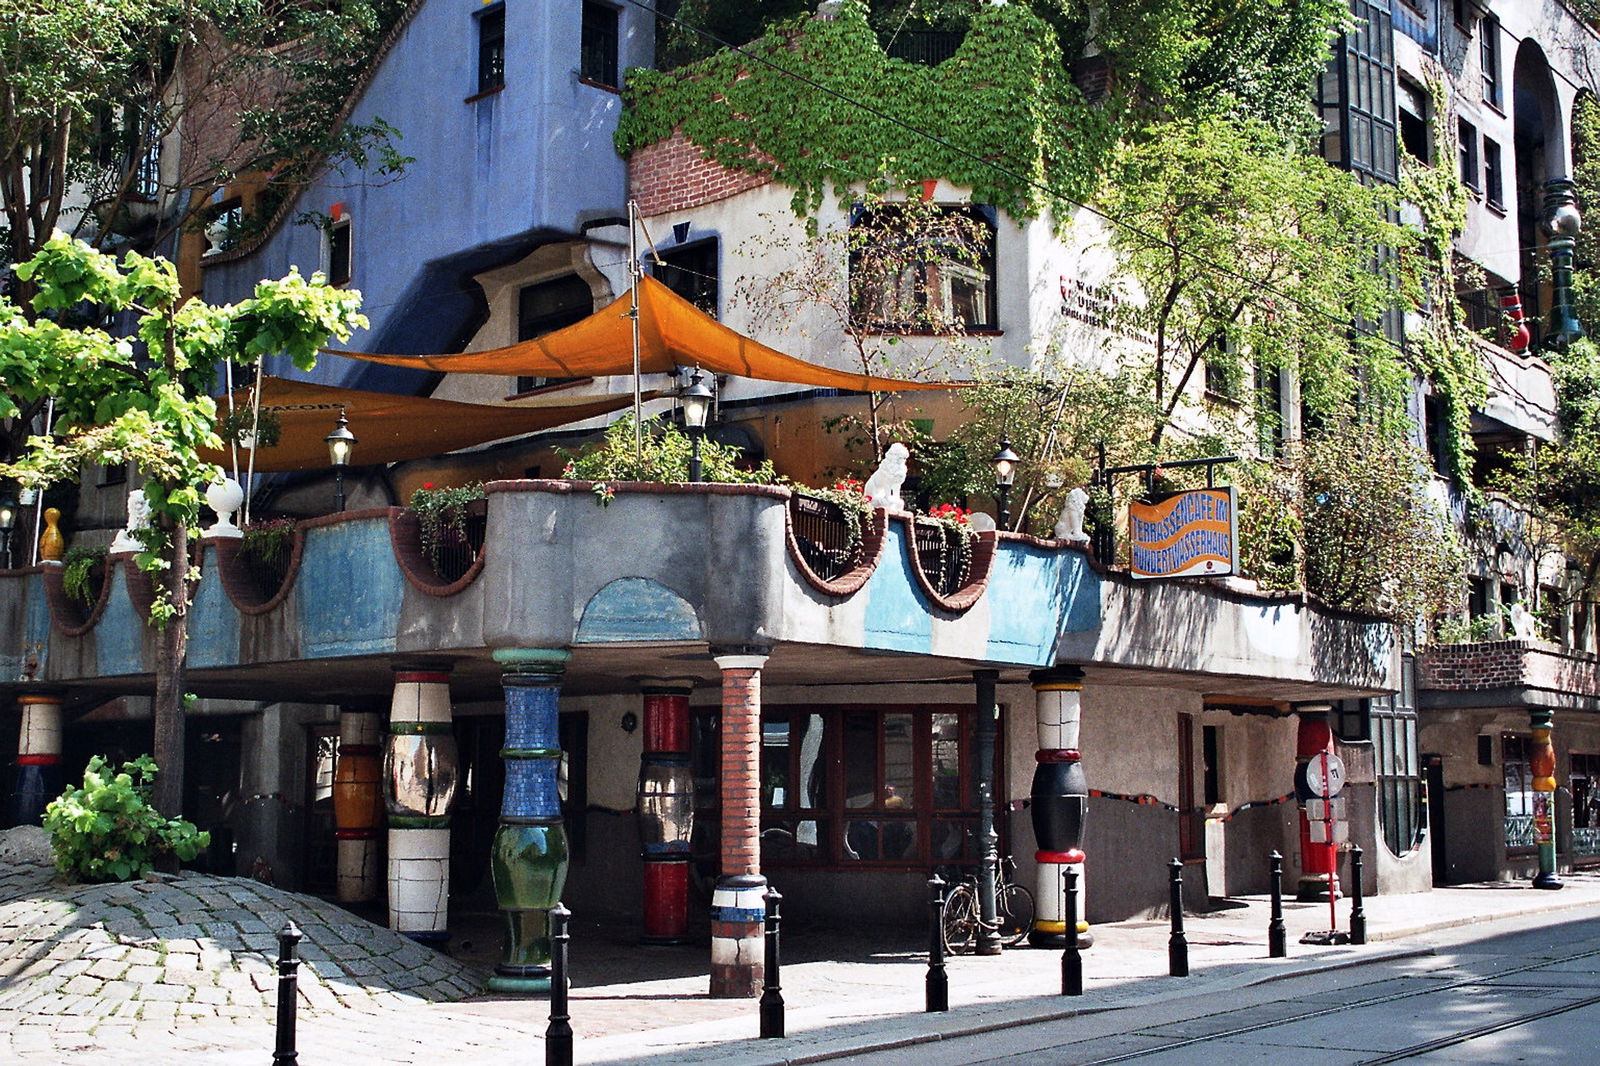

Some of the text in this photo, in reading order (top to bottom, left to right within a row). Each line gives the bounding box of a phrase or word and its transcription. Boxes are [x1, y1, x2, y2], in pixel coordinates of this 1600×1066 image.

[259, 403, 345, 411] JACOBS
[1133, 494, 1228, 542] TERRASSENCAFE IM
[1134, 530, 1229, 573] HUNDERTWASSERHAUS
